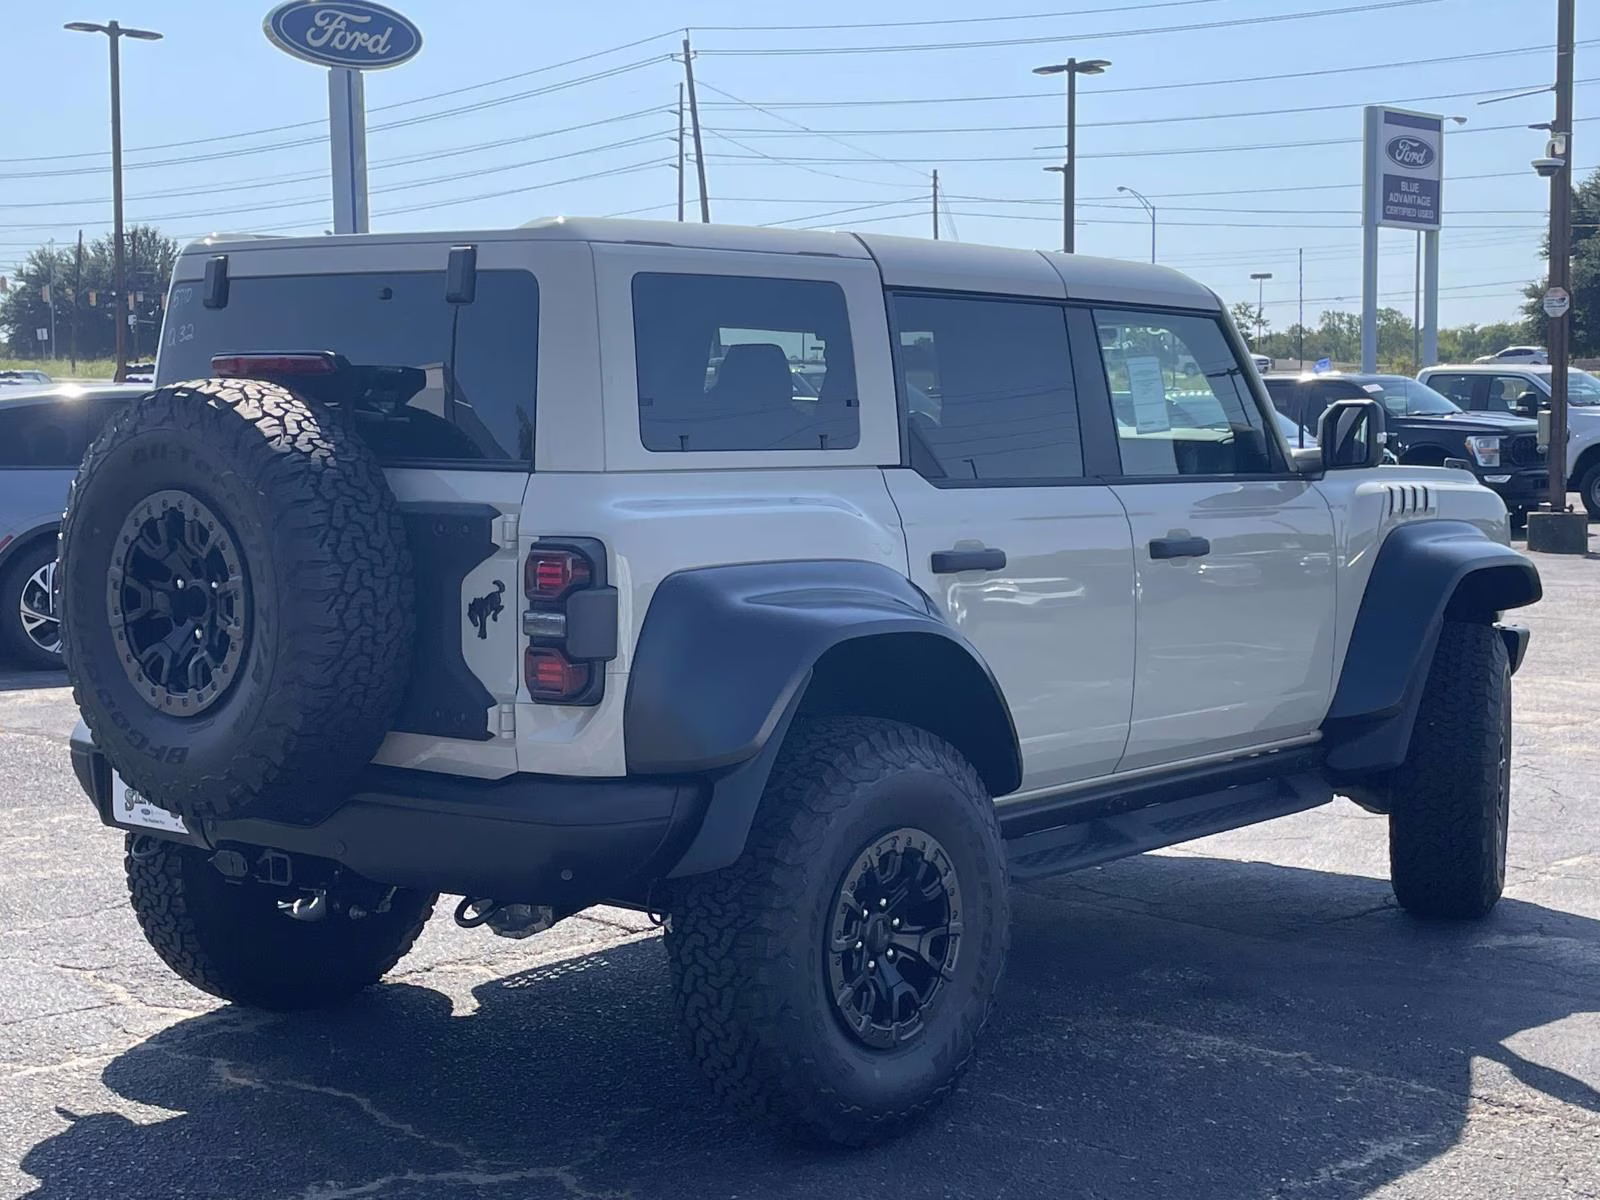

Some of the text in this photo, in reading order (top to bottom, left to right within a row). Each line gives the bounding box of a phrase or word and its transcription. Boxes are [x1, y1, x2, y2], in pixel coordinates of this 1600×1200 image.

[306, 9, 393, 55] Ford
[1395, 139, 1427, 164] Ford
[1400, 181, 1420, 193] BLUE
[1388, 192, 1432, 207] ADVANTAGE
[1385, 205, 1434, 219] CERTIFIED USED
